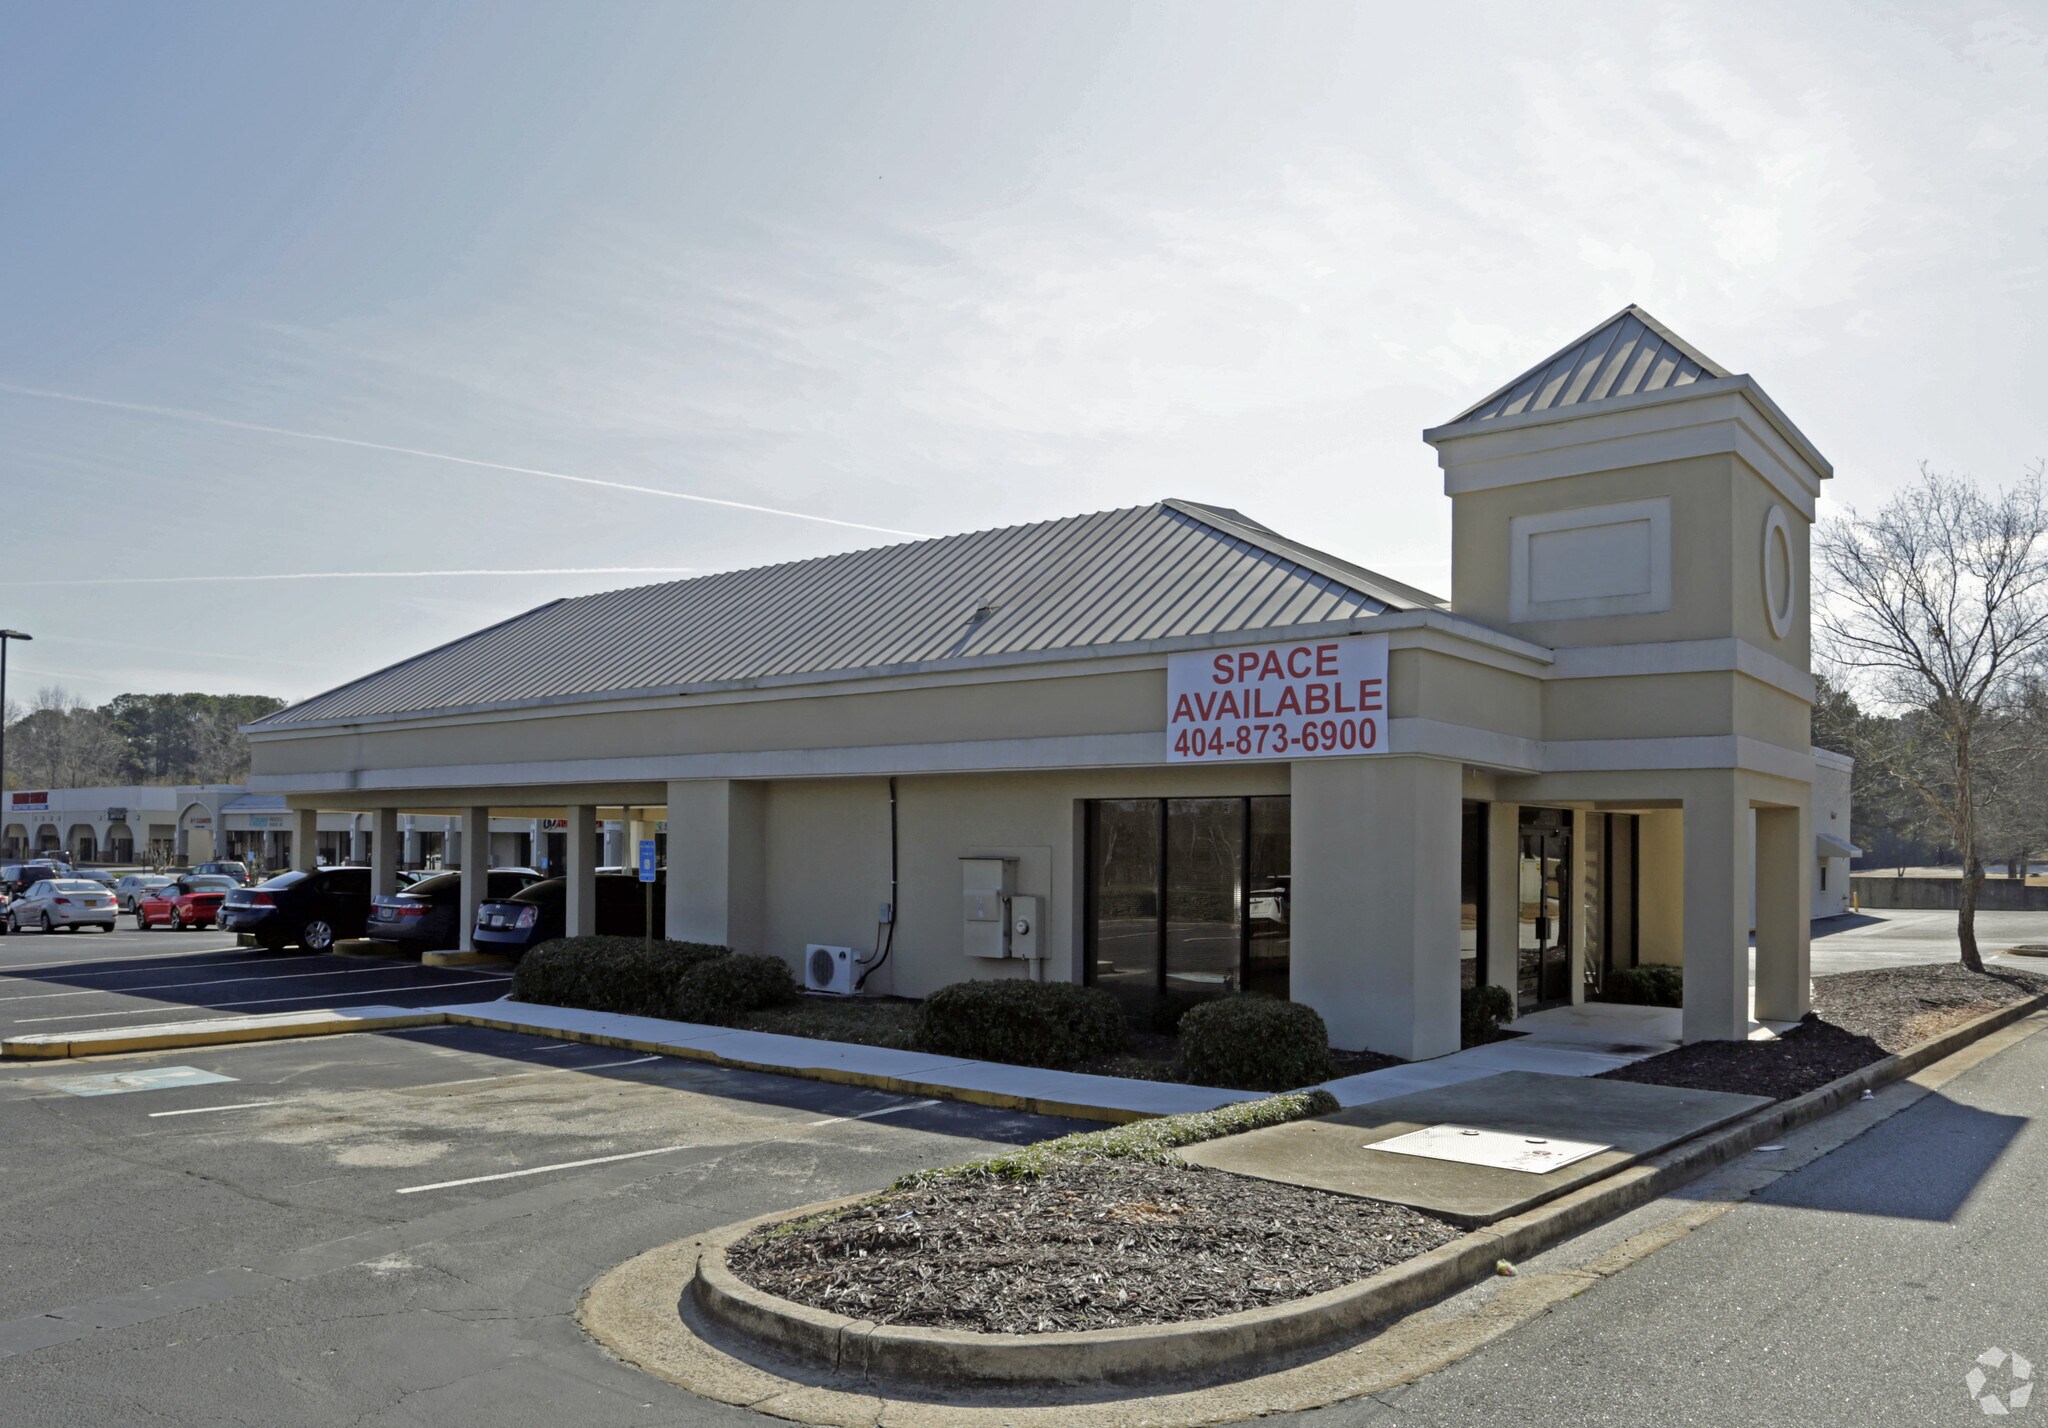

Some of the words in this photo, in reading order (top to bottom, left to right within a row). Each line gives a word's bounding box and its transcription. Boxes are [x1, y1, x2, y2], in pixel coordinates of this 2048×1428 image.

[1212, 644, 1339, 685] SPACE
[1171, 679, 1383, 724] AVAILABLE
[1174, 718, 1377, 757] 404-873-6900
